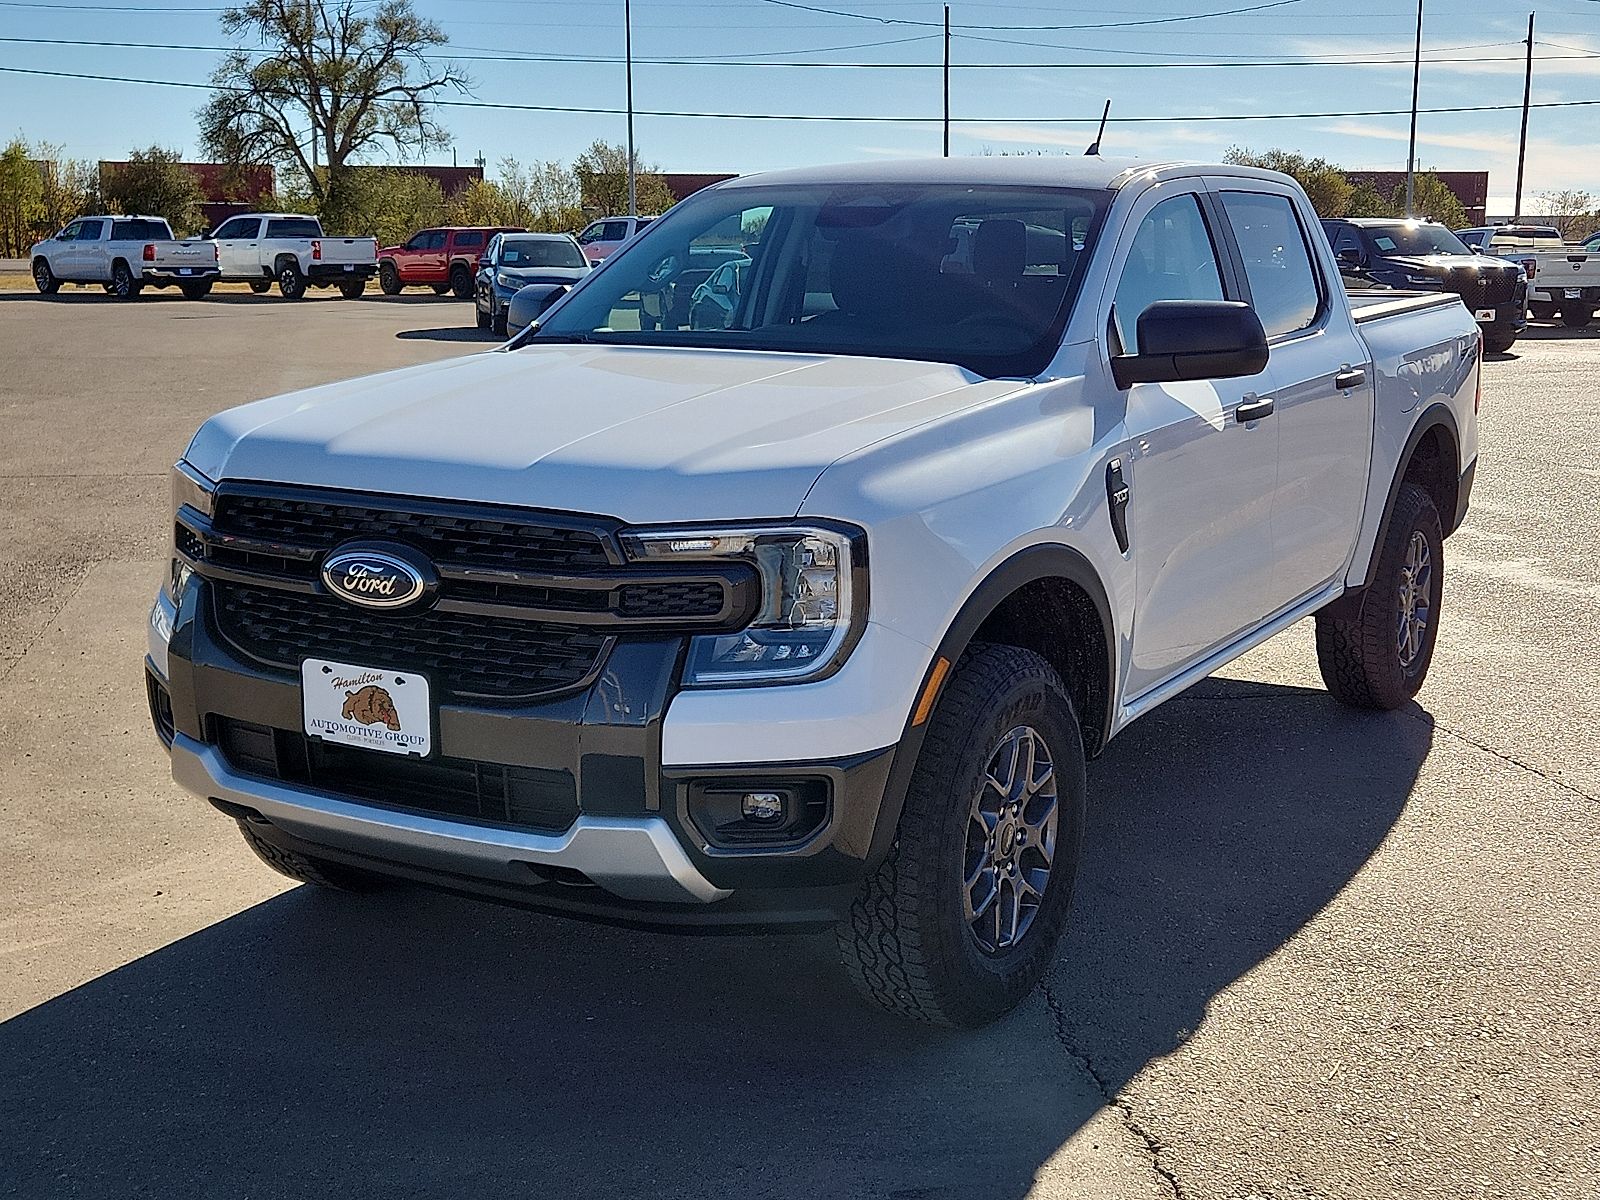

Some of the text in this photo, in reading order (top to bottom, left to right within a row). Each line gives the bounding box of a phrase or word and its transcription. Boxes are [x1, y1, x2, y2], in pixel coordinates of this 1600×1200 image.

[343, 562, 397, 595] Ford
[331, 672, 384, 690] Hamilton
[310, 718, 425, 746] AUTOMOTIVE GROUP
